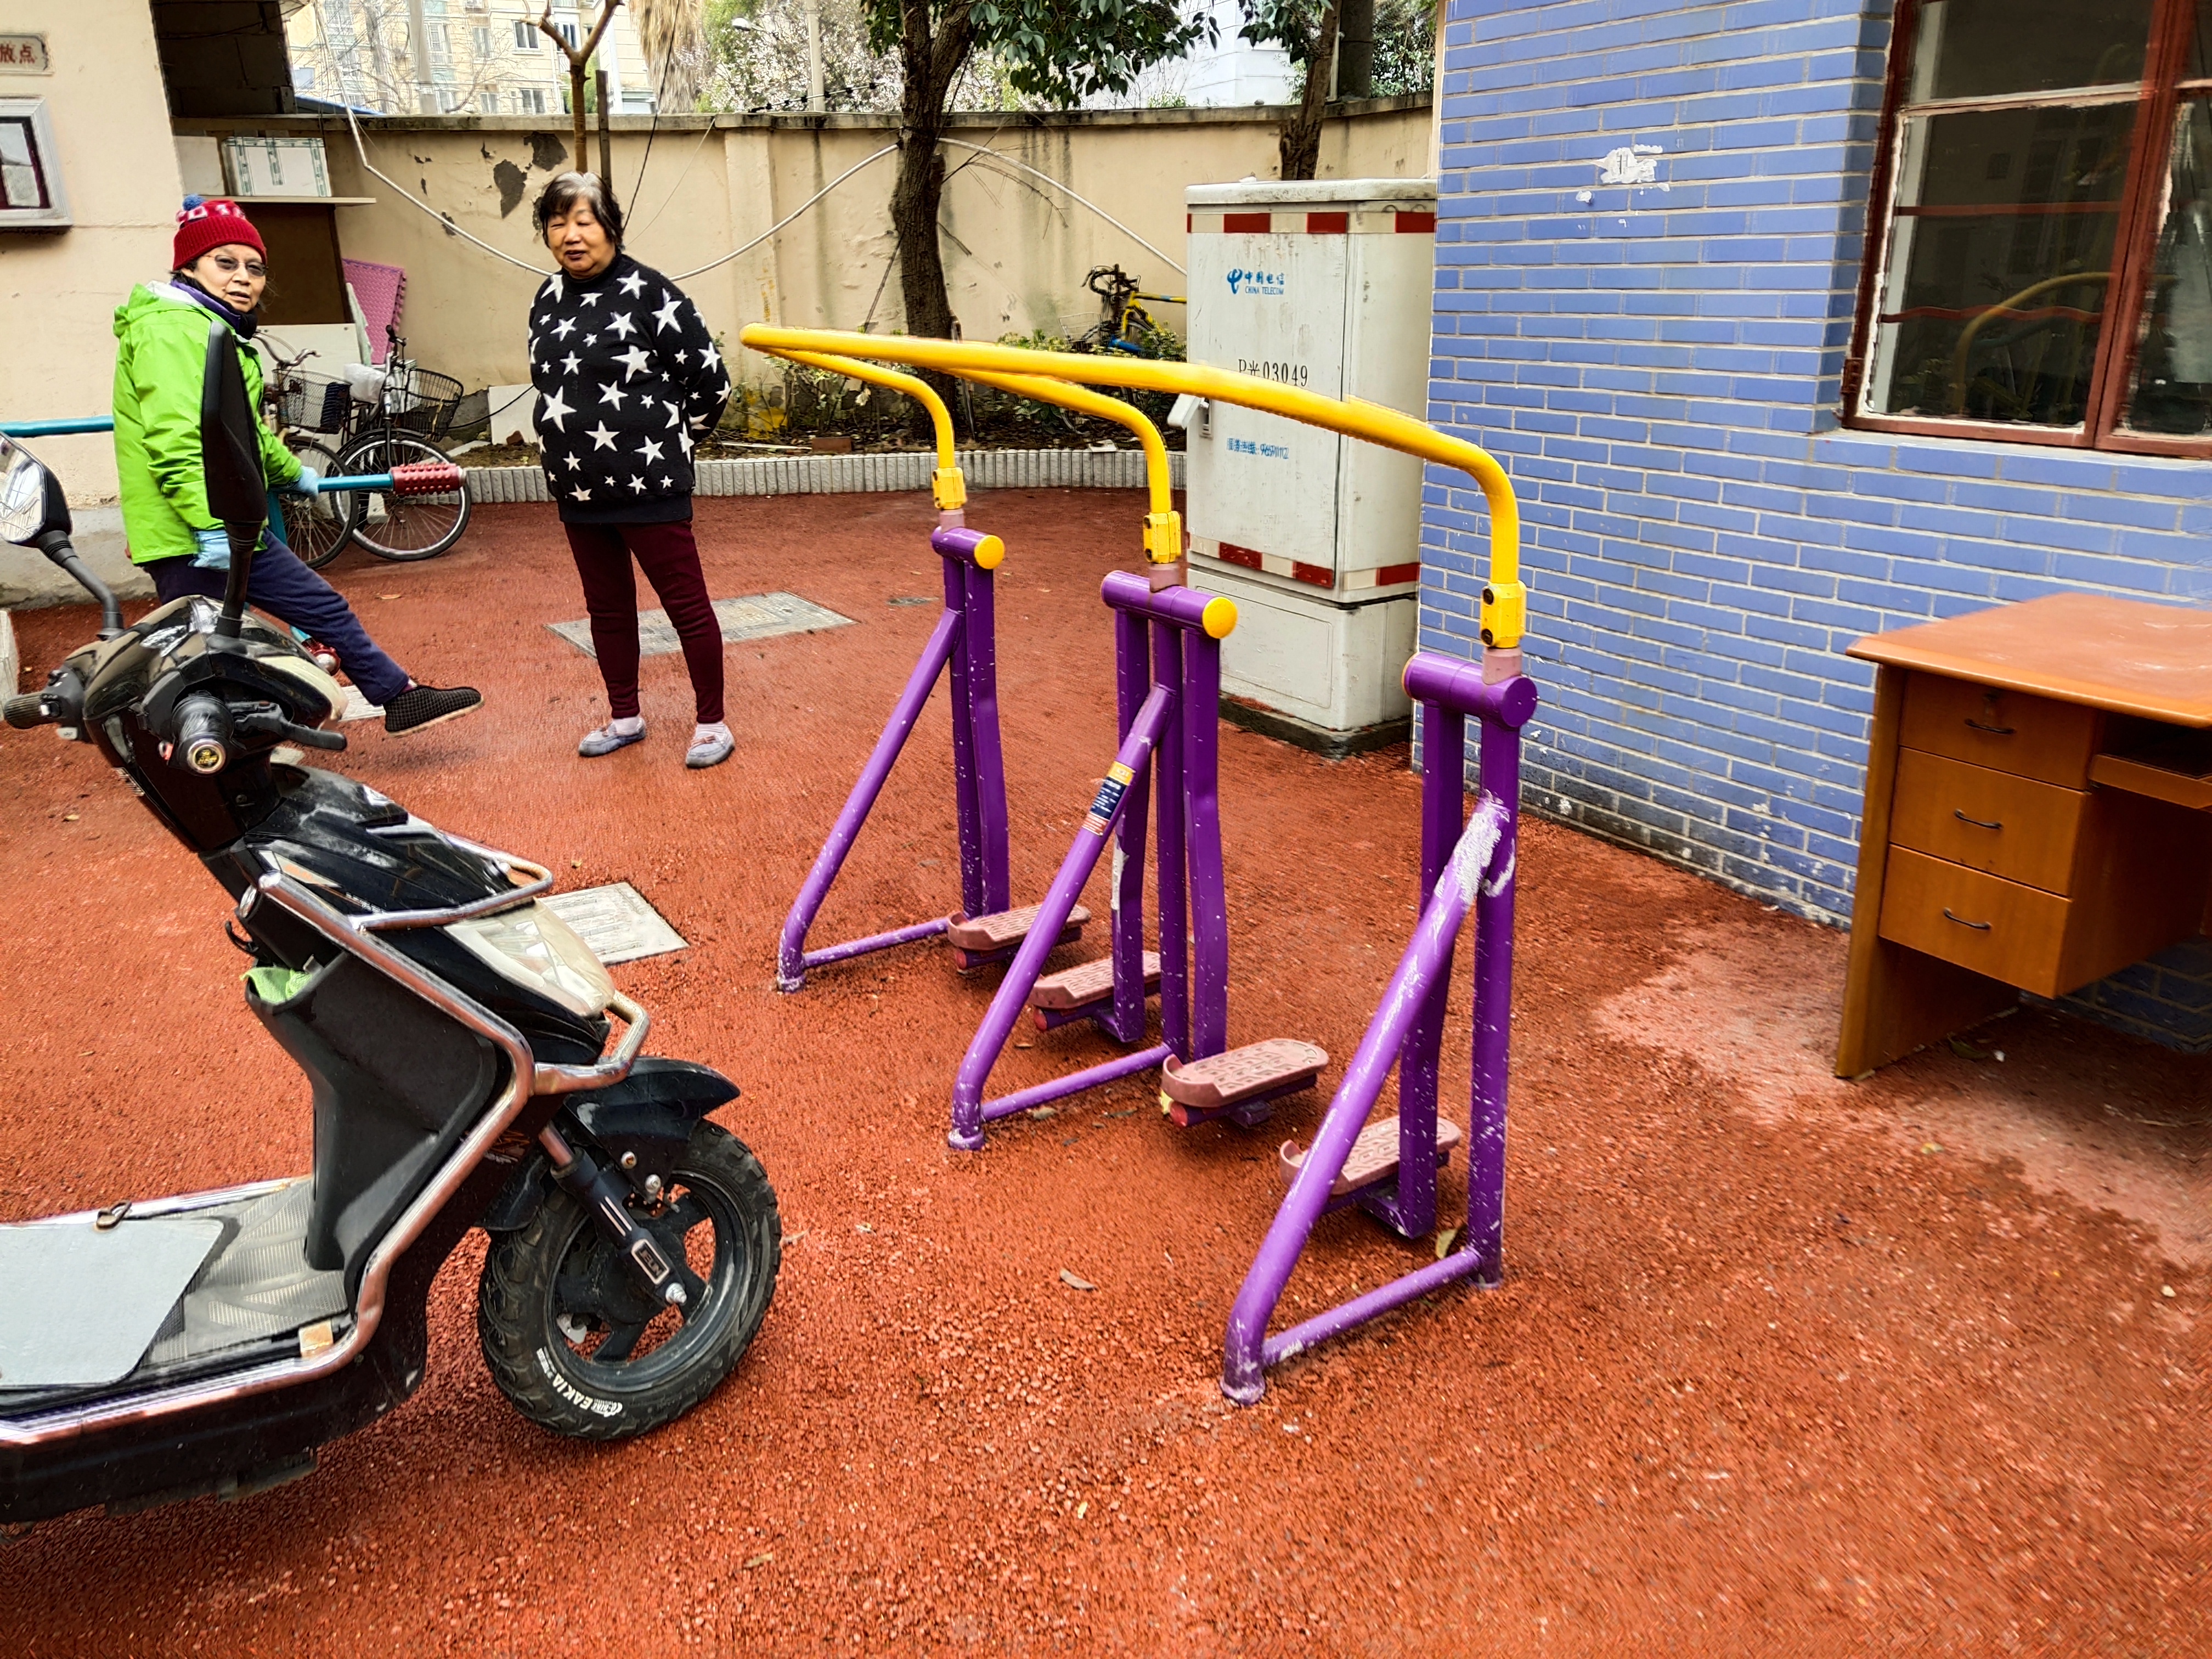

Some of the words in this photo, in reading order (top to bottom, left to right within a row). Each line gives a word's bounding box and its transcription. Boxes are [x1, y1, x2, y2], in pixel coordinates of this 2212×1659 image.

[1244, 270, 1284, 285] 中国电信
[1245, 286, 1259, 294] CHINA
[1262, 286, 1284, 295] TELECOM
